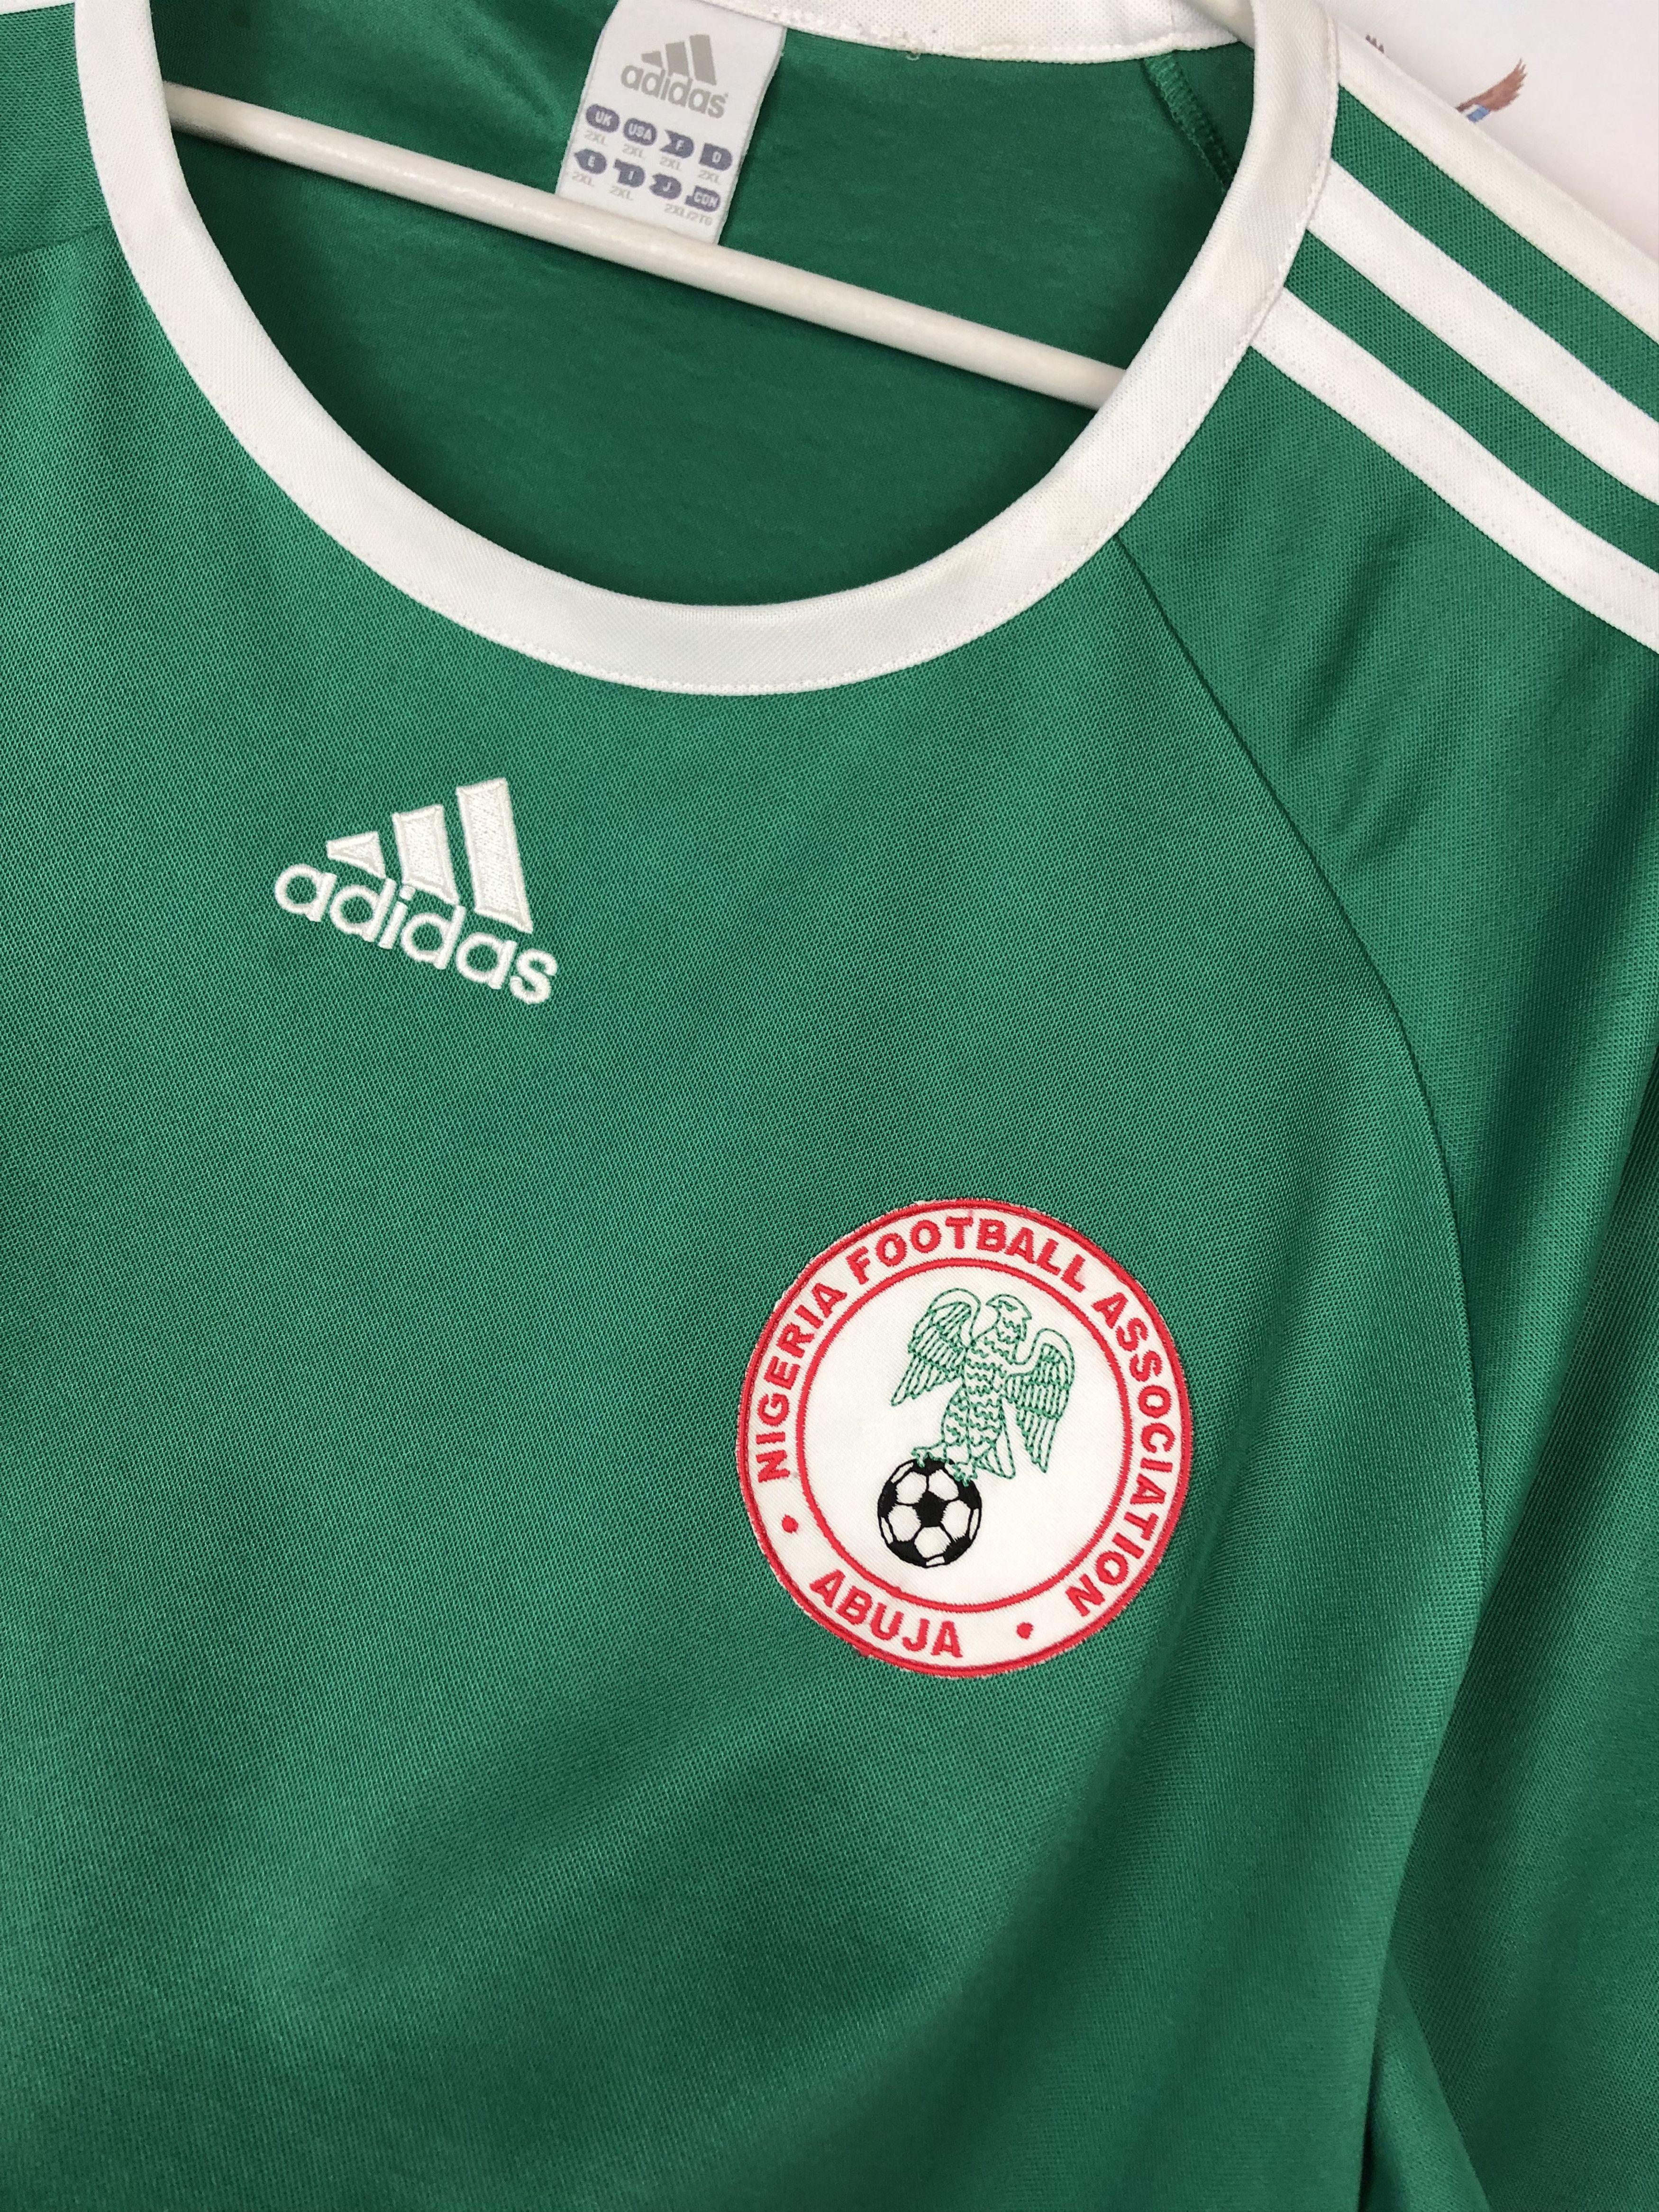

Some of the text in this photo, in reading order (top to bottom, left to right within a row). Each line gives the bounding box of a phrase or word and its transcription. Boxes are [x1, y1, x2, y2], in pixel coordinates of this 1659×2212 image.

[620, 65, 727, 118] adidas
[584, 129, 607, 146] 2XL
[622, 144, 645, 158] 2XL
[660, 156, 682, 172] 2XL
[595, 111, 612, 127] UK
[629, 123, 652, 140] USA
[663, 182, 671, 191] J
[274, 864, 558, 1005] adidas
[755, 1217, 1175, 1617] NIGERIA FOOTBALL ASSOCIATION
[810, 1567, 963, 1658] ABUJA
